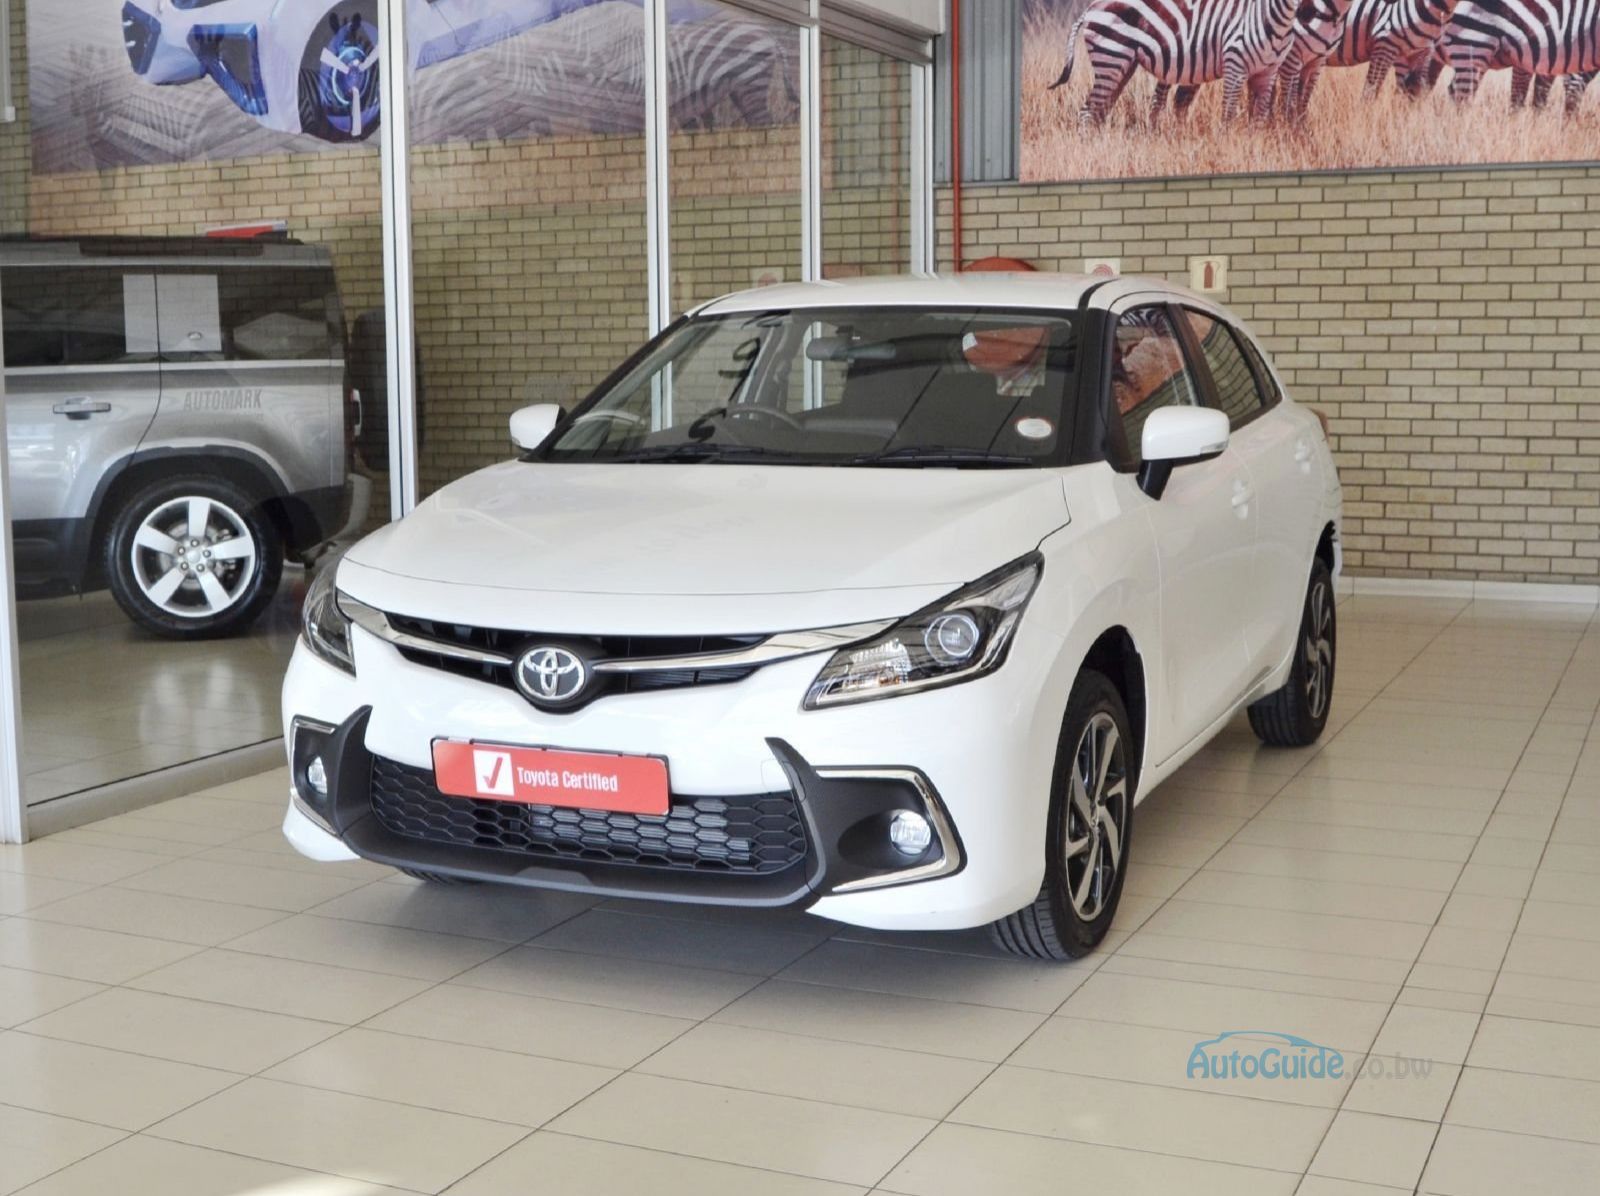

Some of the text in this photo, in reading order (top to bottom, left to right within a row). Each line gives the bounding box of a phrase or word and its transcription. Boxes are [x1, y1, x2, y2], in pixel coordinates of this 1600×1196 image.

[184, 389, 262, 410] AUTOMARK
[517, 767, 619, 792] Toyota Certified
